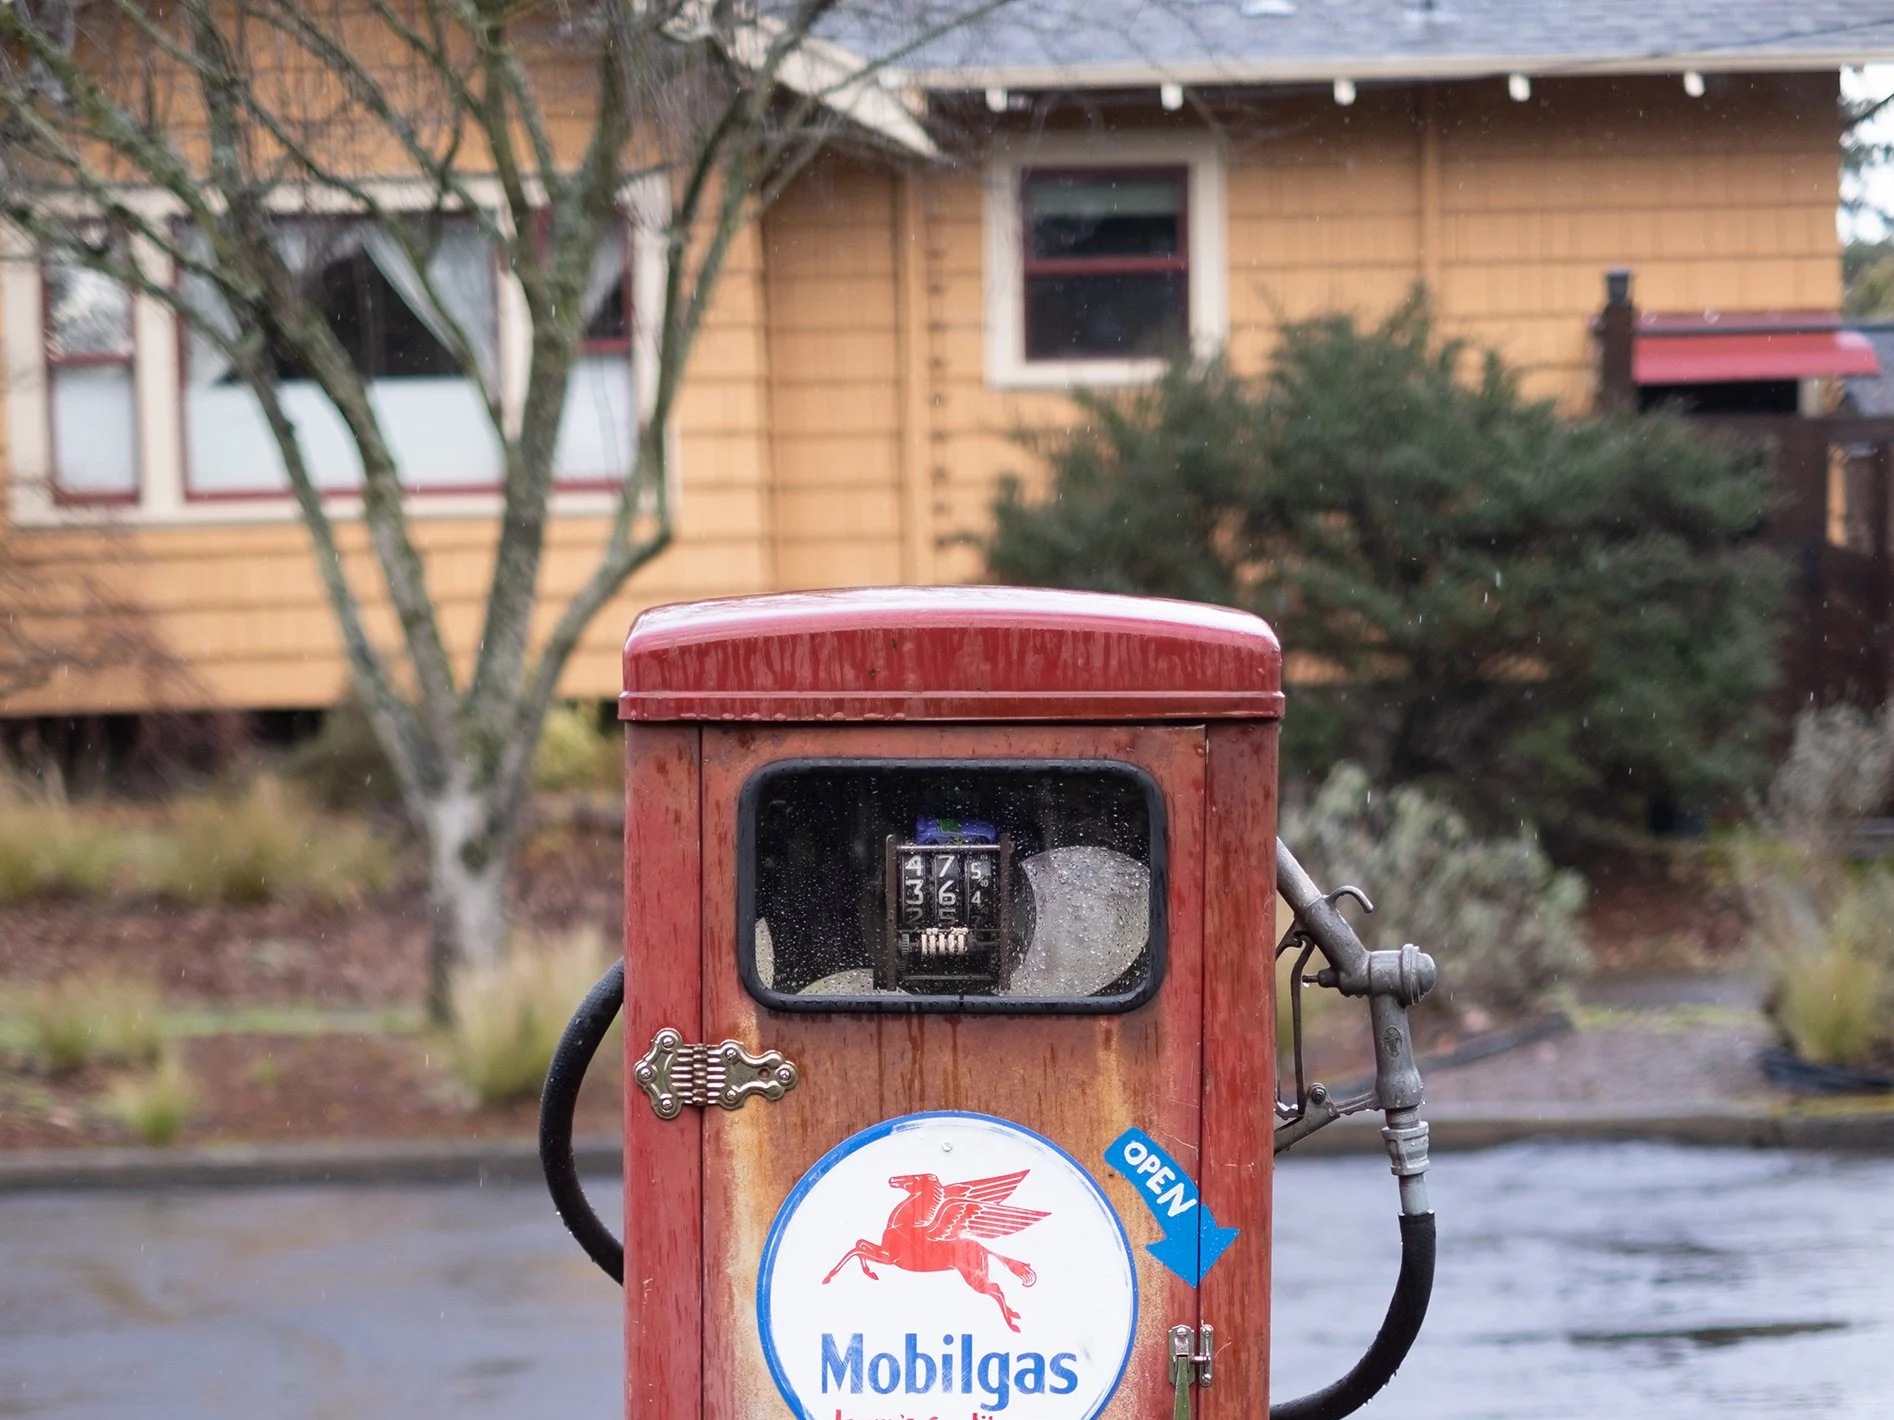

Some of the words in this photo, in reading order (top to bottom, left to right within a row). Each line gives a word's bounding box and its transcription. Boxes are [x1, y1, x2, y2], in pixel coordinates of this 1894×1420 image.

[905, 855, 923, 877] 4
[938, 854, 956, 878] 7
[905, 879, 924, 905] 3
[938, 879, 956, 905] 6
[1123, 1140, 1198, 1218] OPEN
[820, 1332, 1079, 1412] Mobilgas
